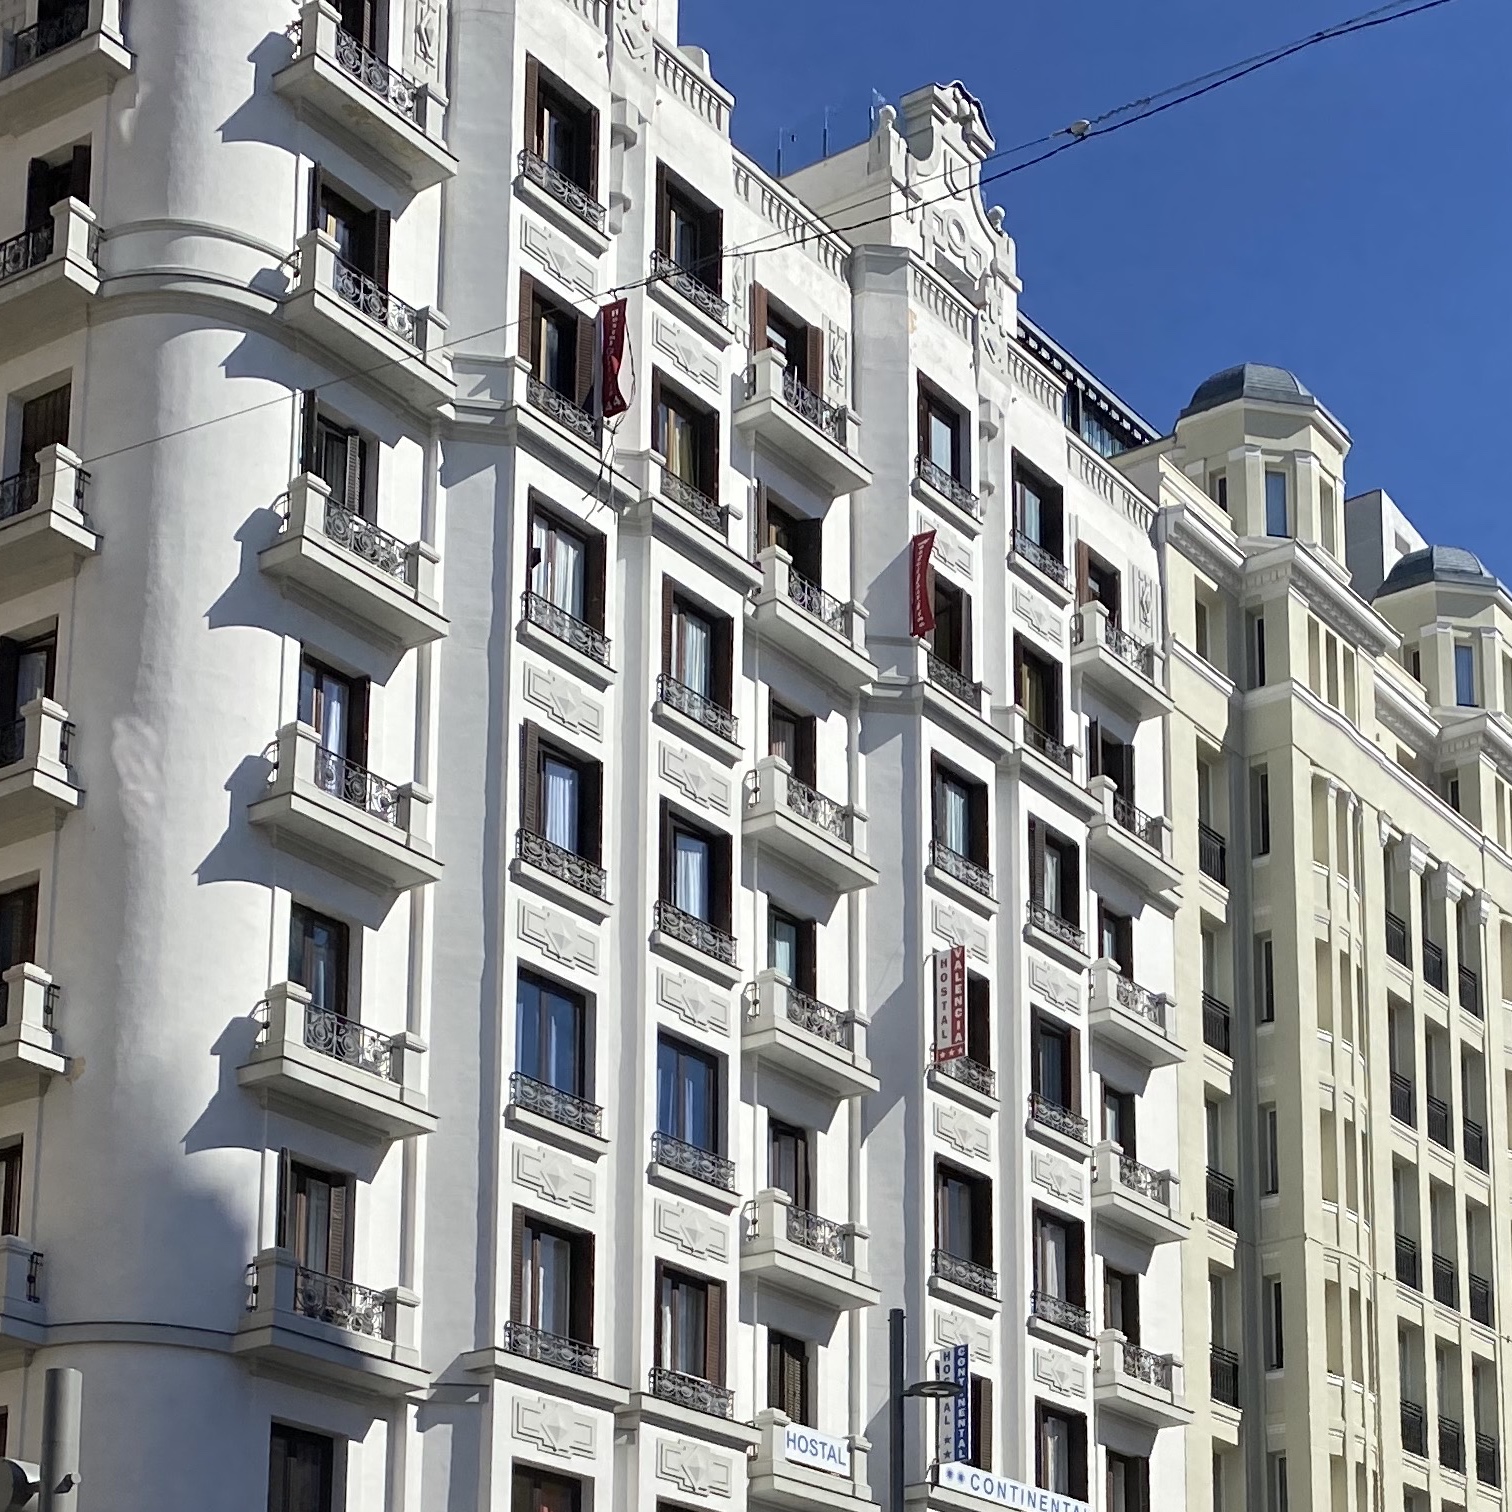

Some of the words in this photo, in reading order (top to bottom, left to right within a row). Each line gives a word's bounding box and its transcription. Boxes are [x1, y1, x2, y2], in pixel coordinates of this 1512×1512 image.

[940, 958, 948, 1039] HOSTAL
[953, 947, 963, 1043] VALENCIA
[943, 1351, 951, 1425] HOAL
[957, 1346, 966, 1458] CONTNENTAL
[787, 1430, 846, 1466] HOSTAL
